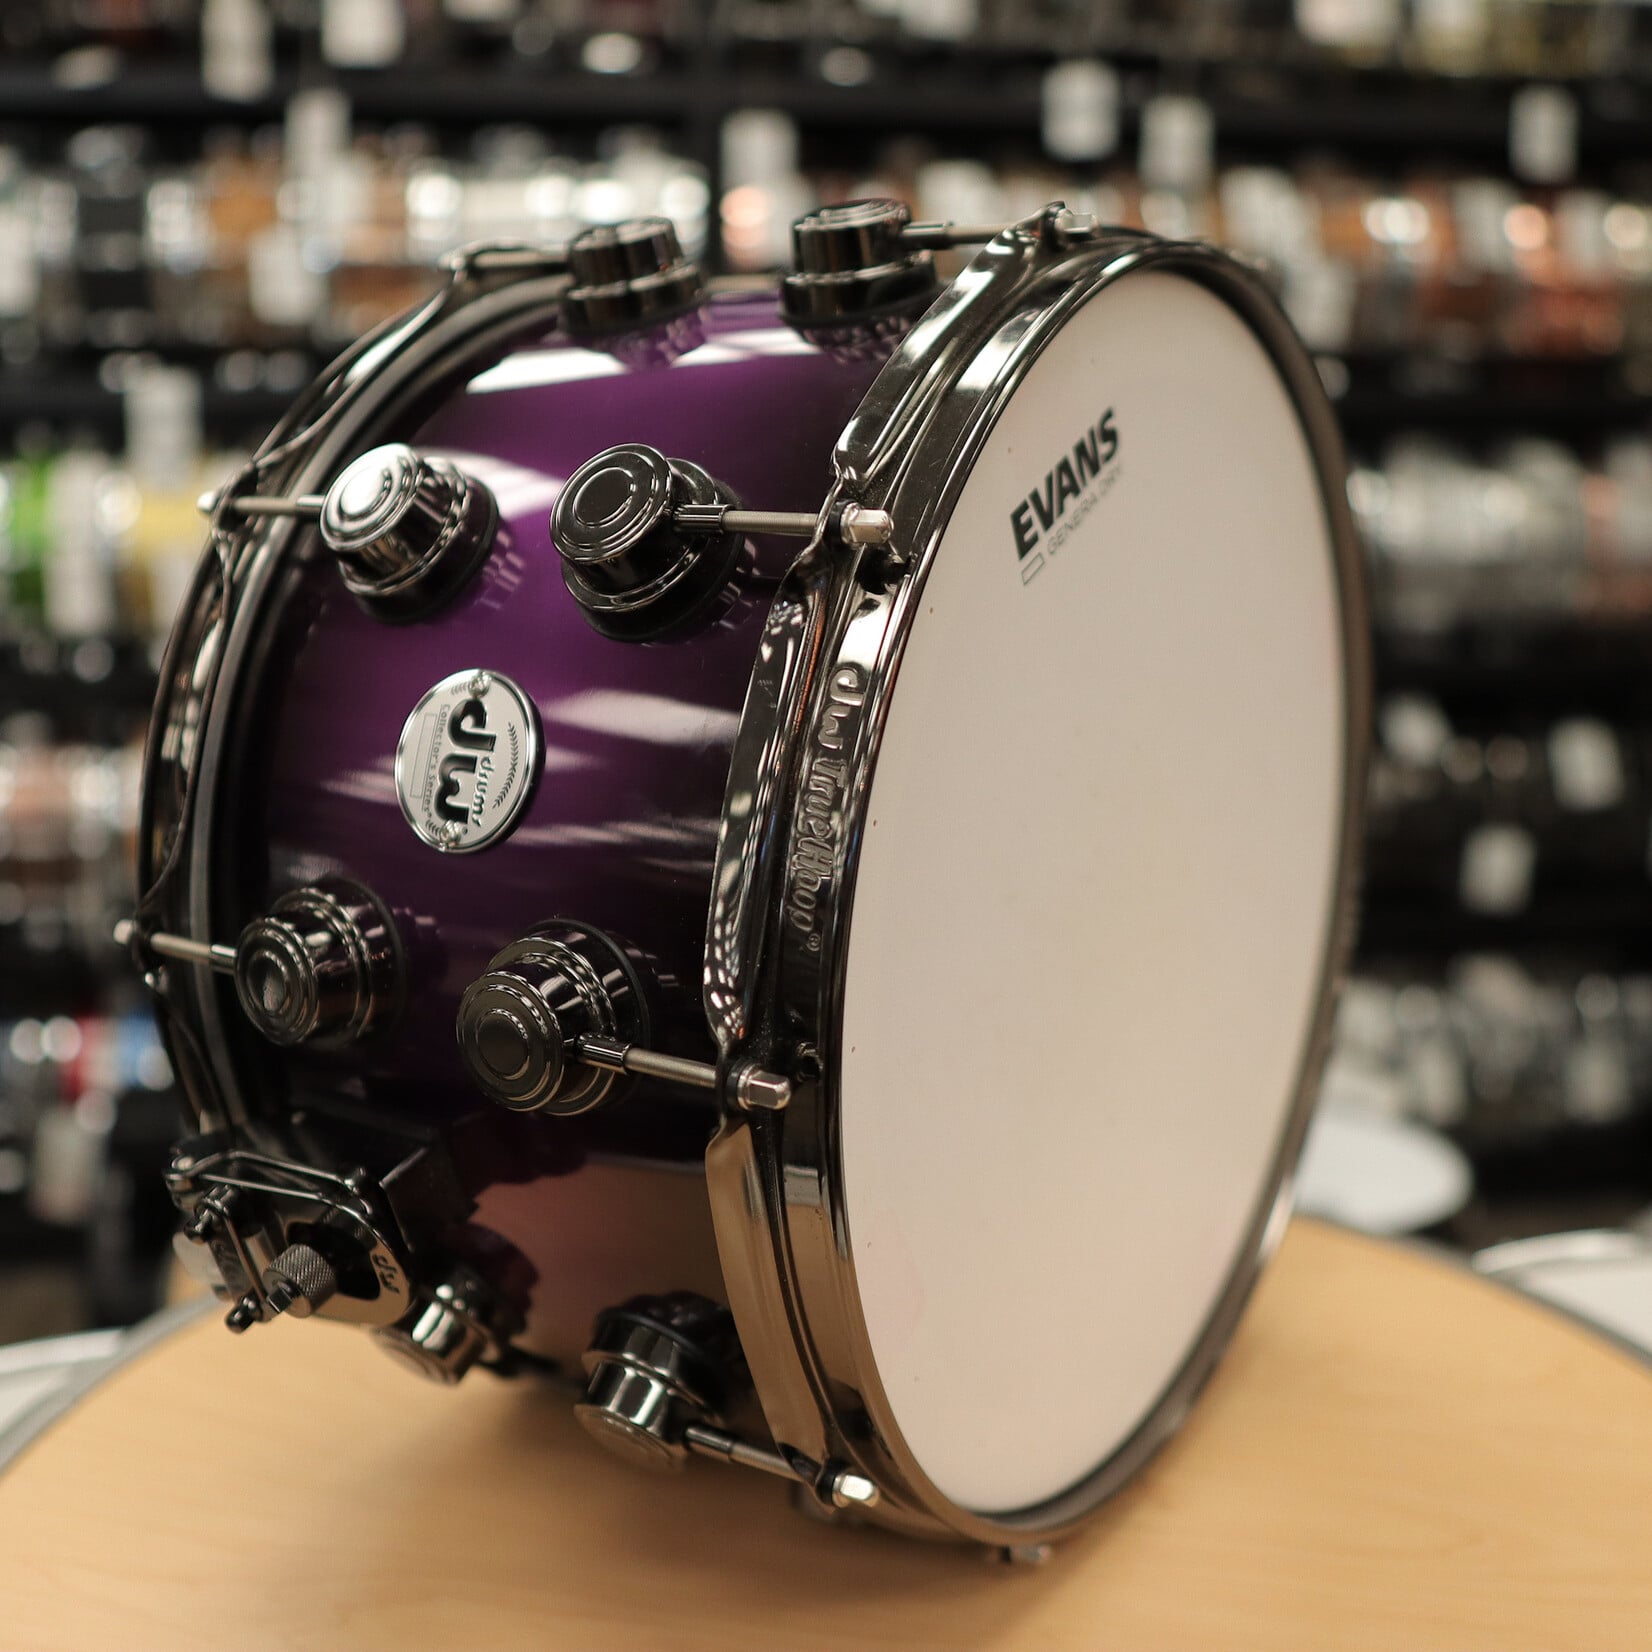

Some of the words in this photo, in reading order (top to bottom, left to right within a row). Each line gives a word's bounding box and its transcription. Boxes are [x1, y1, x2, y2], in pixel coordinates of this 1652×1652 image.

[1010, 406, 1119, 561] EVANS
[1047, 495, 1098, 555] GENERA
[430, 704, 451, 772] Collector's
[472, 756, 495, 827] drums
